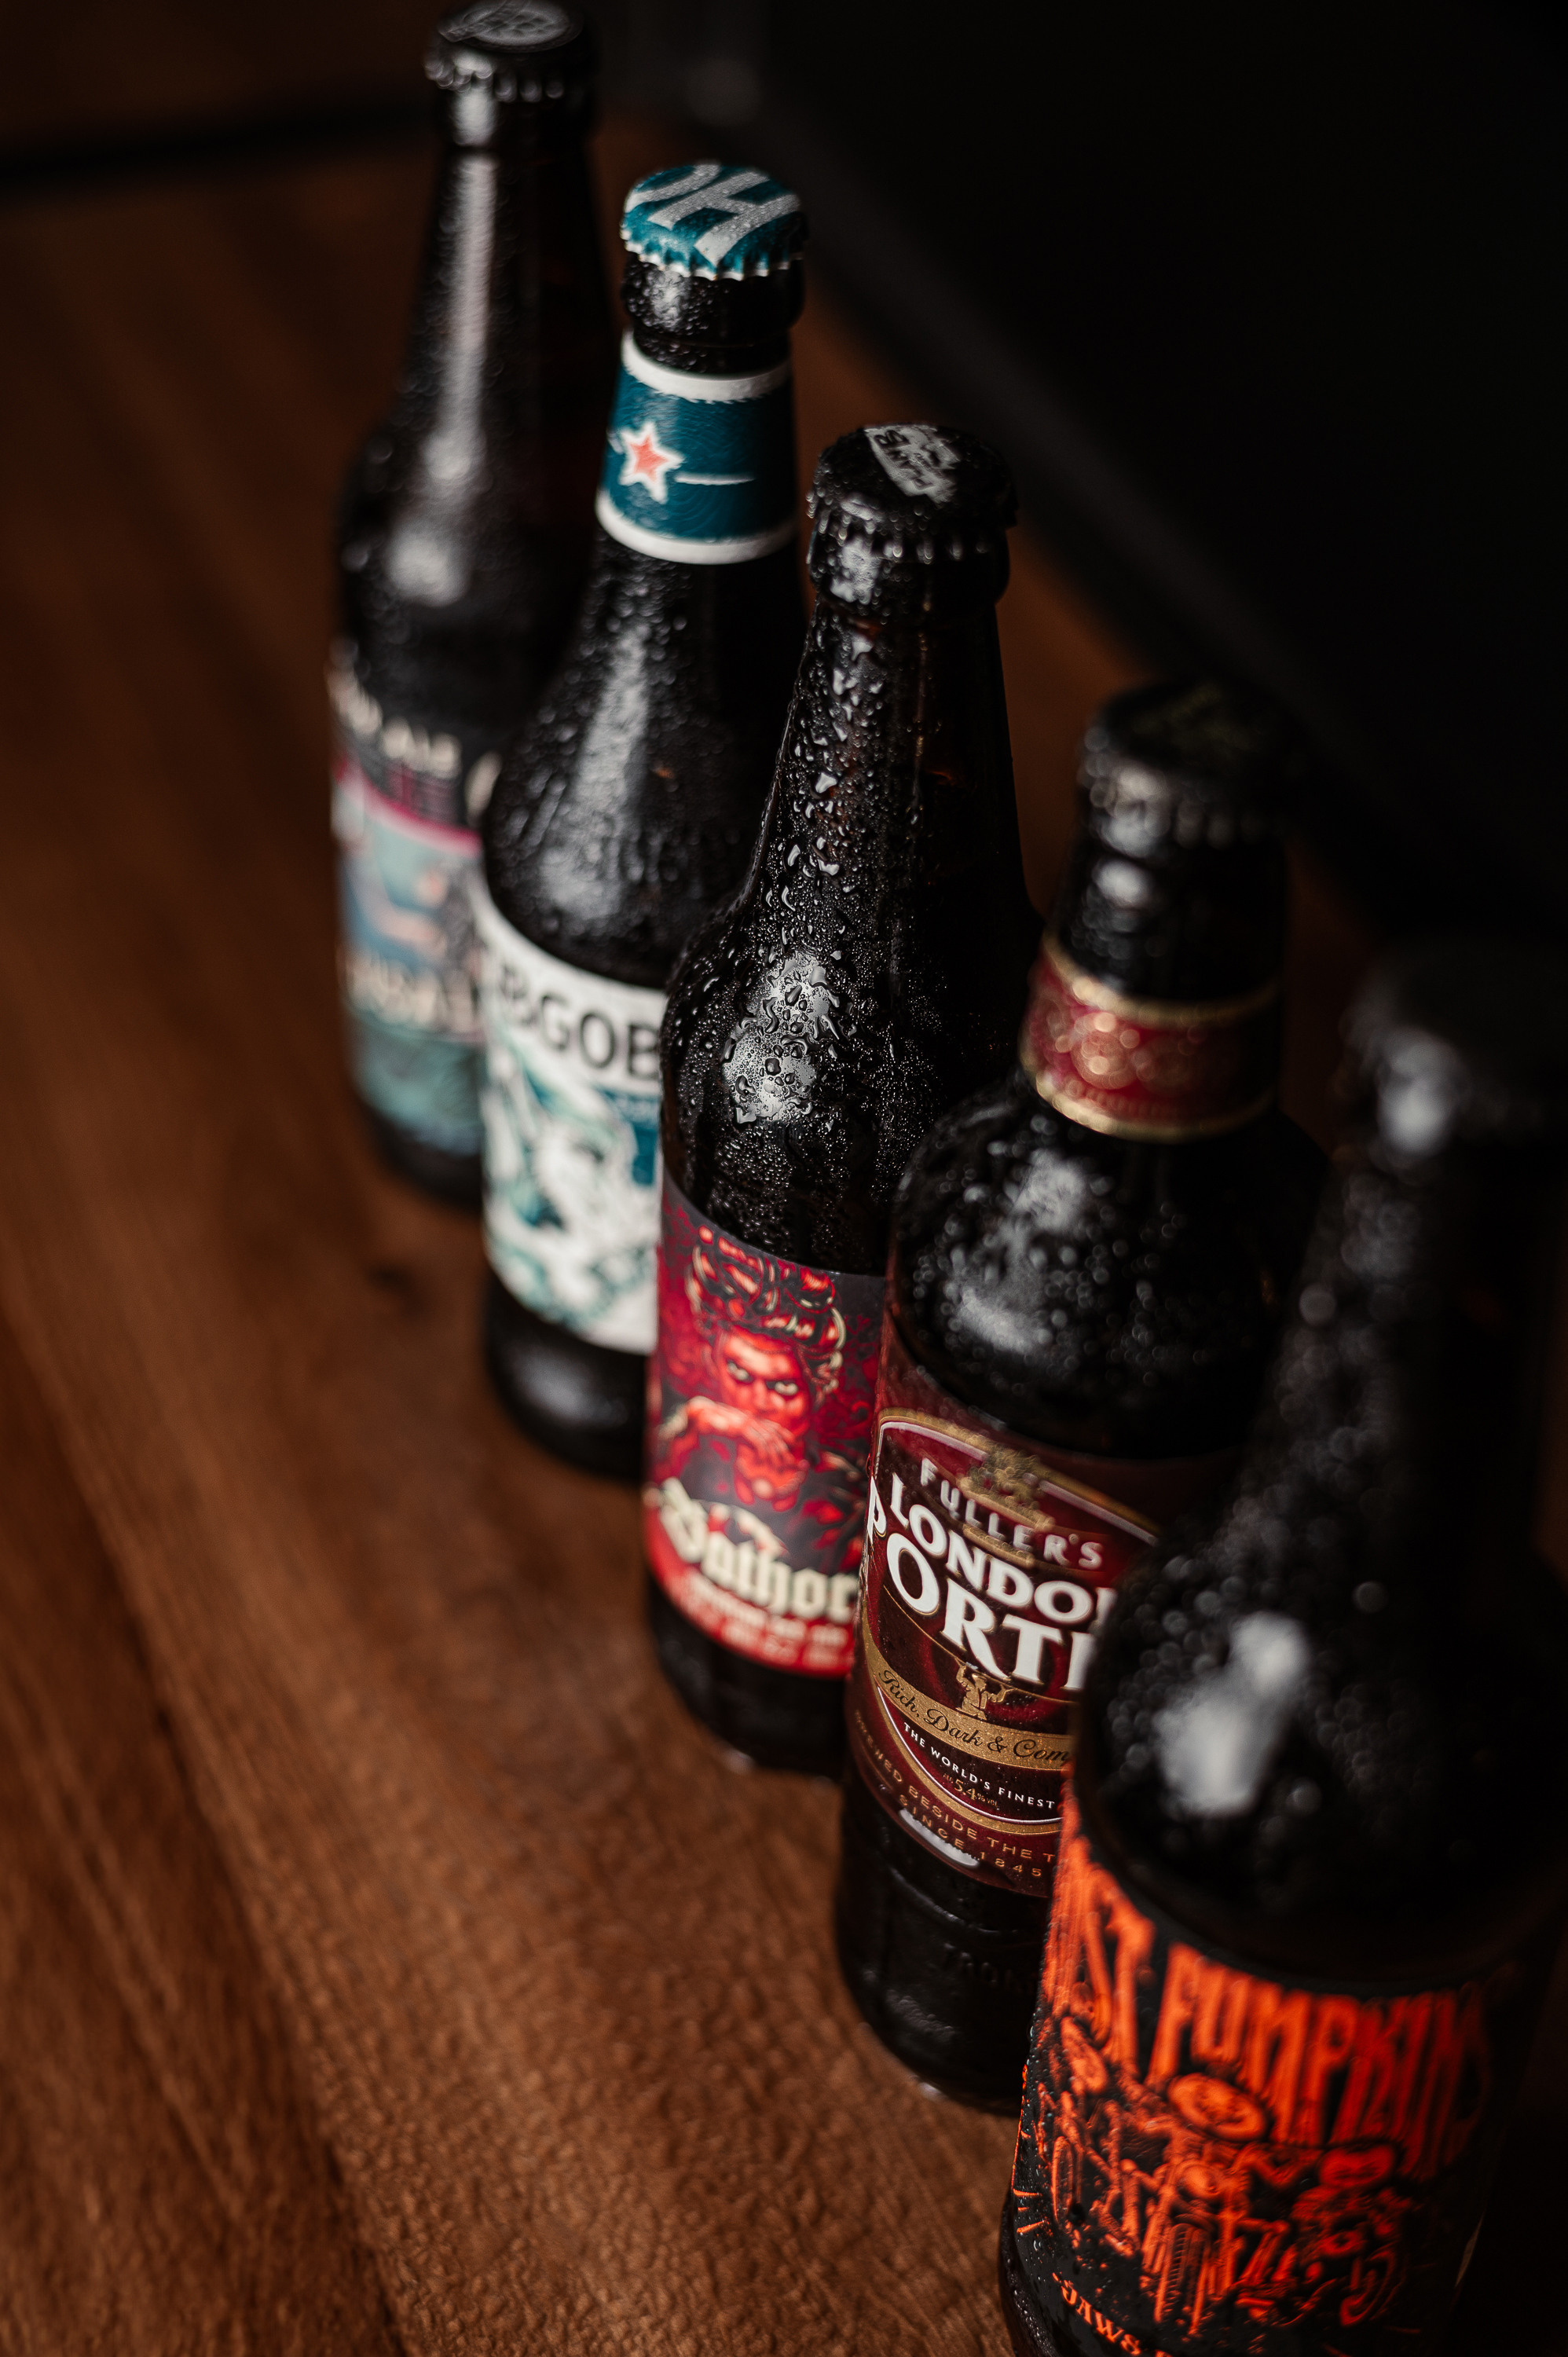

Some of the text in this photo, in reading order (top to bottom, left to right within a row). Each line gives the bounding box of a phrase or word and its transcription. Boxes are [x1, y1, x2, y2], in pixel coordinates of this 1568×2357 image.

[920, 1457, 1103, 1569] FULLER'S
[878, 1669, 920, 1718] Rich,
[924, 1708, 984, 1747] Dark
[987, 1736, 1007, 1753] &
[903, 1721, 1055, 1809] THE WORLD'S FINEST
[899, 1794, 1042, 1876] SINCE 1845
[909, 1785, 977, 1840] BESIDE
[987, 1836, 1032, 1859] THE
